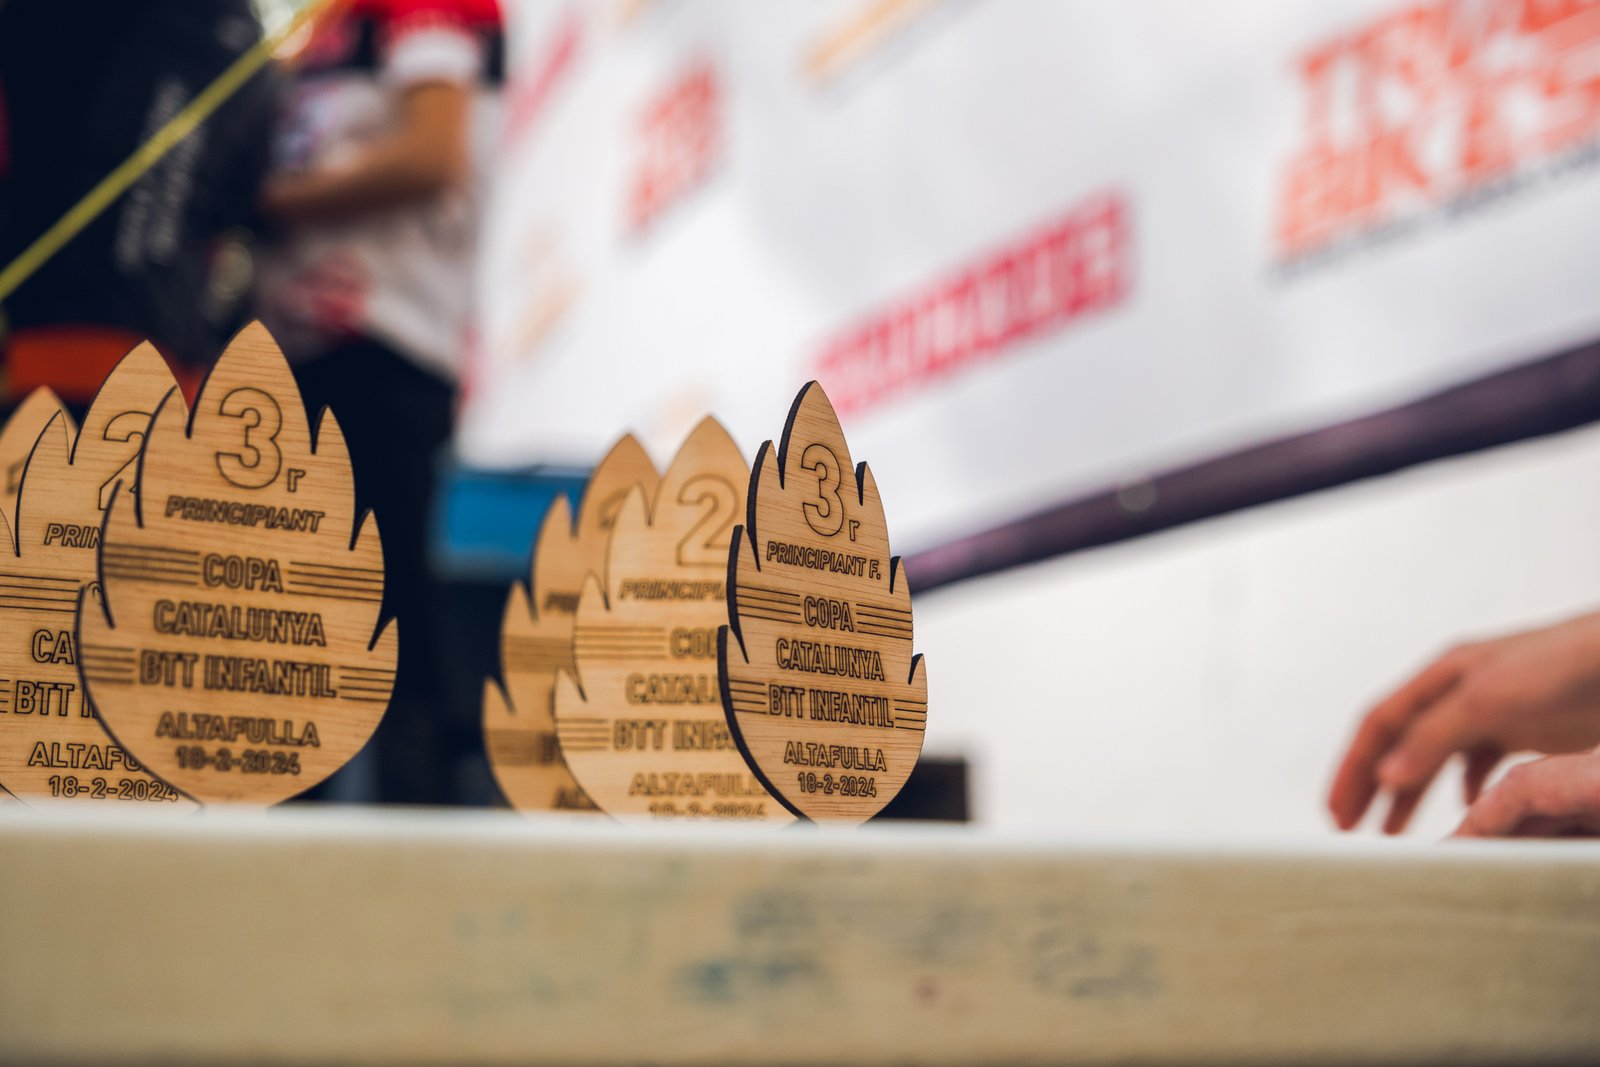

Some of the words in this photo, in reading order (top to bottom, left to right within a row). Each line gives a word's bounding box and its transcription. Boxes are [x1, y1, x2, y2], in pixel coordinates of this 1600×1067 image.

[164, 494, 326, 534] PRINCIPIANT
[203, 552, 284, 594] COPA
[766, 540, 867, 578] PRINCIPIANT
[868, 558, 882, 581] F.
[618, 577, 727, 601] PRINCIPI
[153, 598, 328, 648] CATALUNYA
[803, 595, 854, 633] COPA
[139, 649, 199, 689] BTT
[203, 654, 338, 699] INFANTIL
[776, 637, 886, 682] CATALUNYA
[13, 680, 75, 717] BTT
[768, 683, 806, 719] BTT
[809, 688, 894, 728] INFANTIL
[155, 710, 321, 749] ALTAFULLA
[612, 718, 668, 751] BTT
[175, 745, 303, 777] 18-2-2024
[783, 740, 888, 773] ALTAFULLA
[49, 774, 179, 803] 18-2-2024
[797, 771, 877, 798] 18-2-2024
